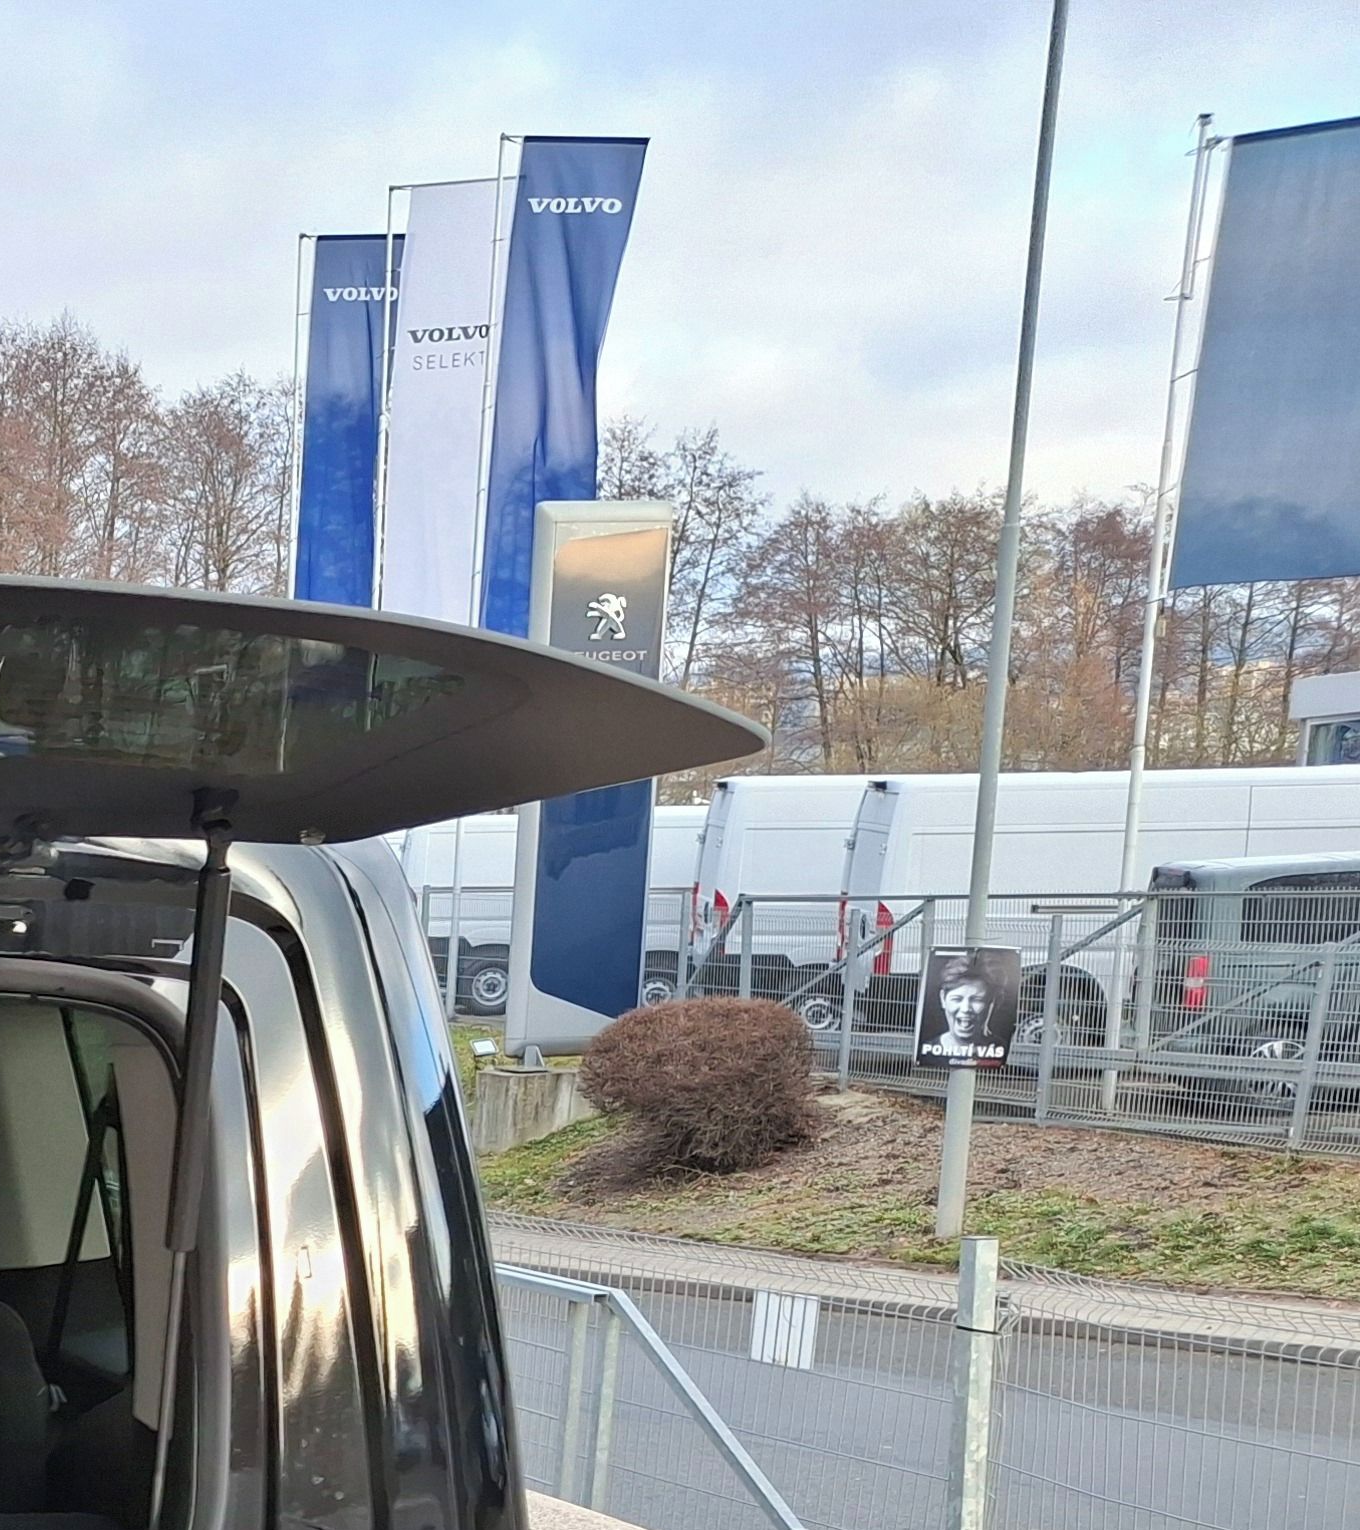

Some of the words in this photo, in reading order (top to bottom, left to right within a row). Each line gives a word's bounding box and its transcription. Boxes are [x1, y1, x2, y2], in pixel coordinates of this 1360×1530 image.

[528, 197, 623, 214] VOLVO
[407, 324, 490, 343] VOLVO
[573, 650, 648, 661] UGEOT
[921, 1042, 975, 1057] POHLTÍ
[976, 1043, 1005, 1058] VÁS
